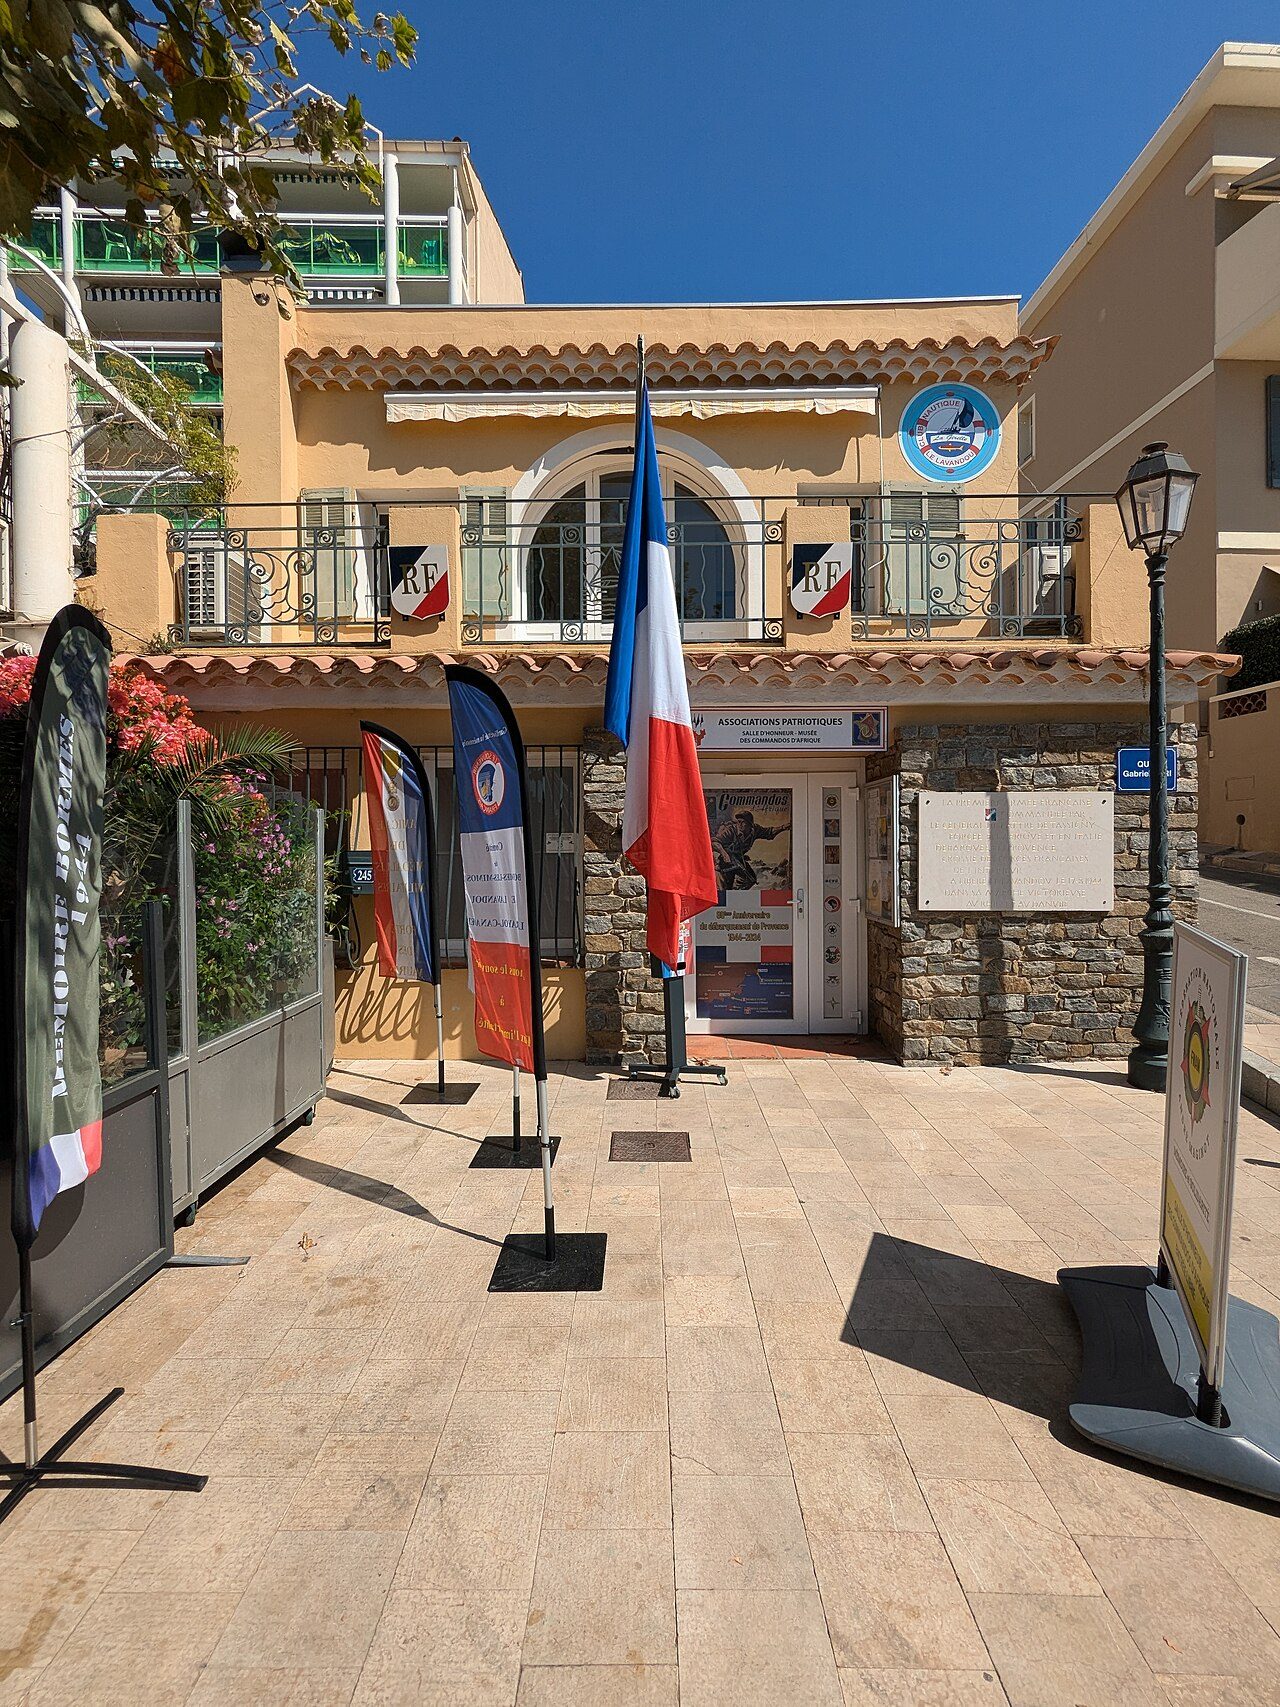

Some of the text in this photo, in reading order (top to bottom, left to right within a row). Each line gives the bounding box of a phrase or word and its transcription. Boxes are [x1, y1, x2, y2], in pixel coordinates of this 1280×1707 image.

[917, 400, 960, 447] CLUB NAUTIQUE
[925, 451, 975, 466] LE LAVANDOU
[400, 563, 438, 594] RF
[802, 561, 841, 593] RF
[718, 718, 843, 727] ASSOCIATIONS PATRIOTIQUES
[56, 713, 74, 883] BORMES
[718, 793, 789, 811] Commandos
[71, 833, 92, 926] 1944
[357, 870, 372, 881] 245
